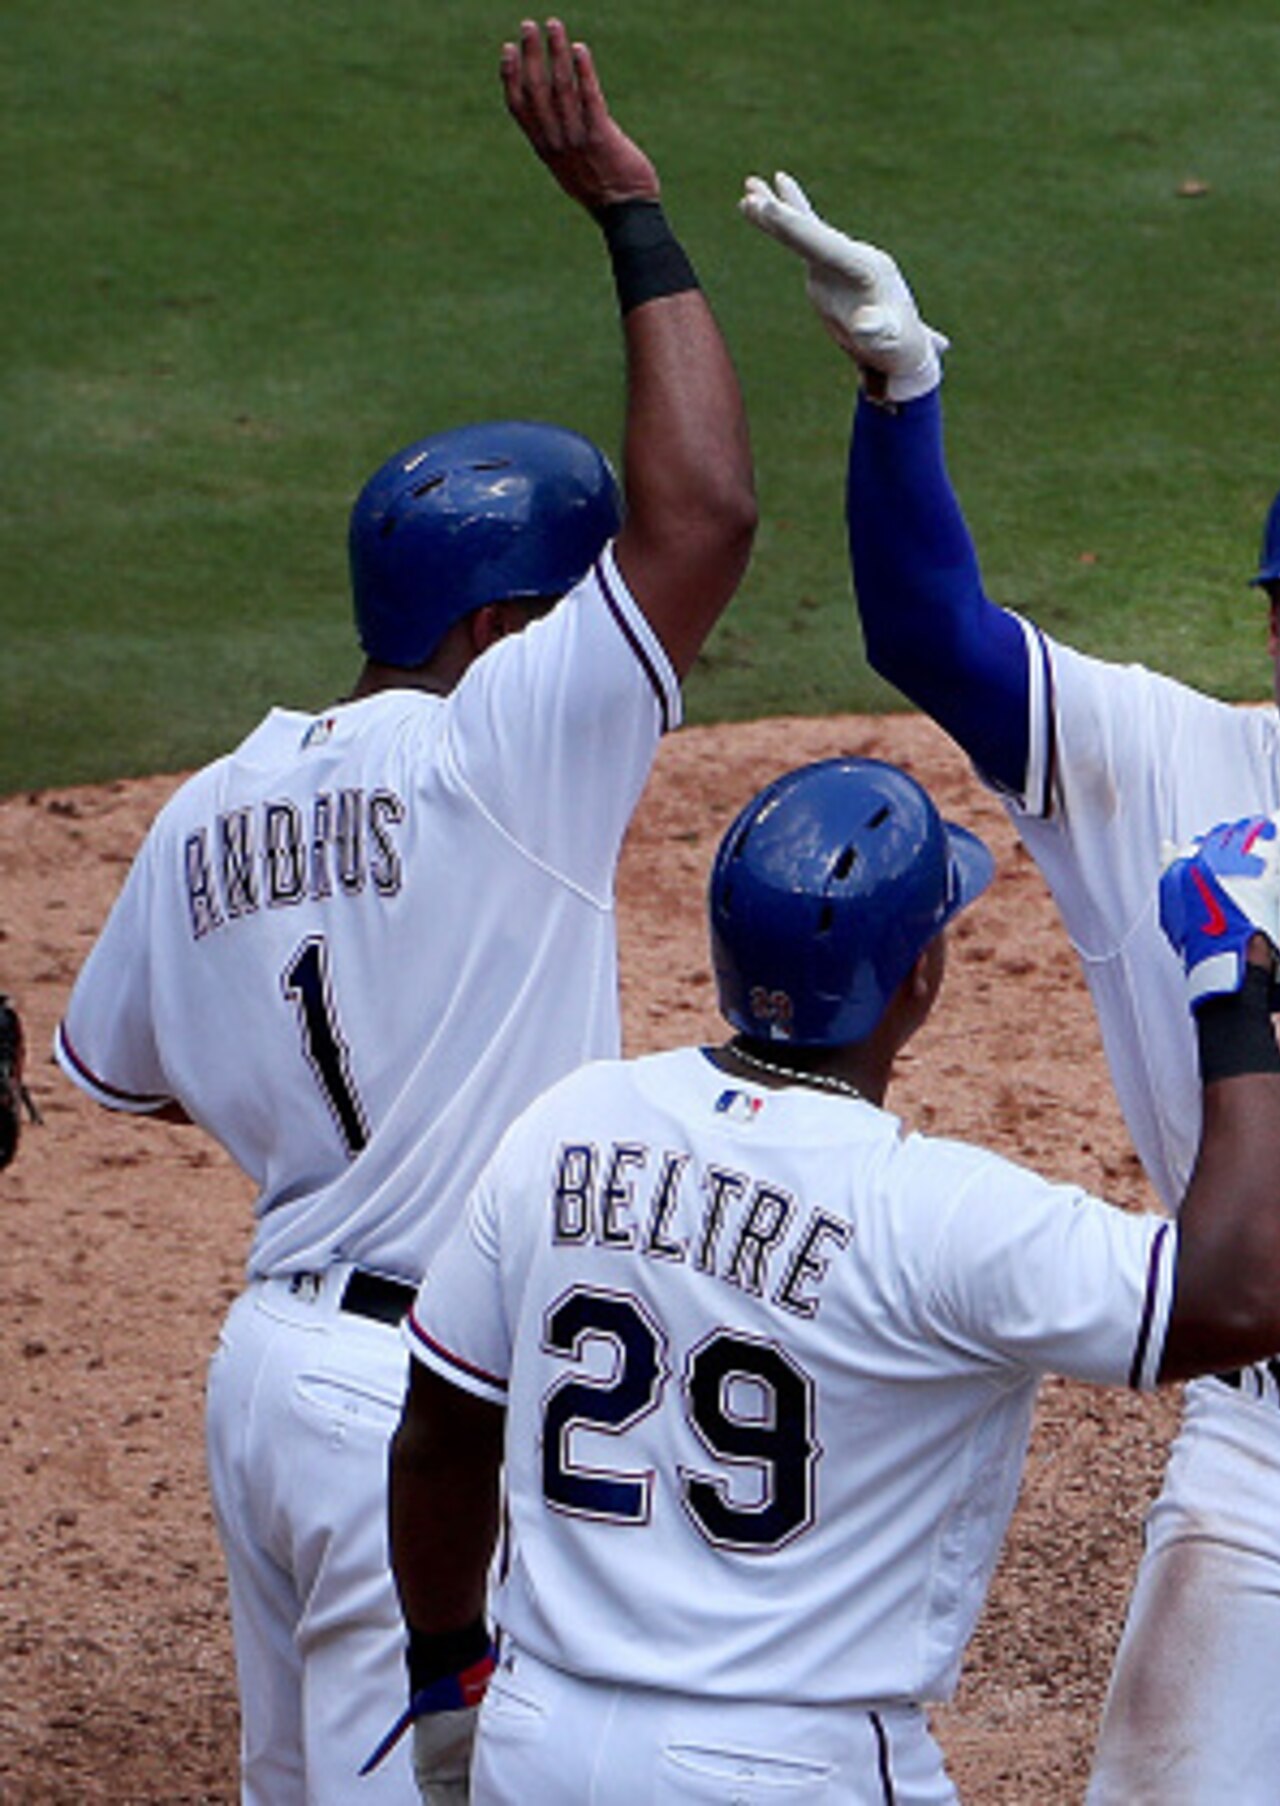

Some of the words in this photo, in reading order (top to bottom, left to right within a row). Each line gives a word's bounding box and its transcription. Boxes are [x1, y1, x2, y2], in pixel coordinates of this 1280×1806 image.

[280, 935, 372, 1162] 1
[552, 1141, 854, 1320] BELTRE
[540, 1283, 824, 1555] 29
